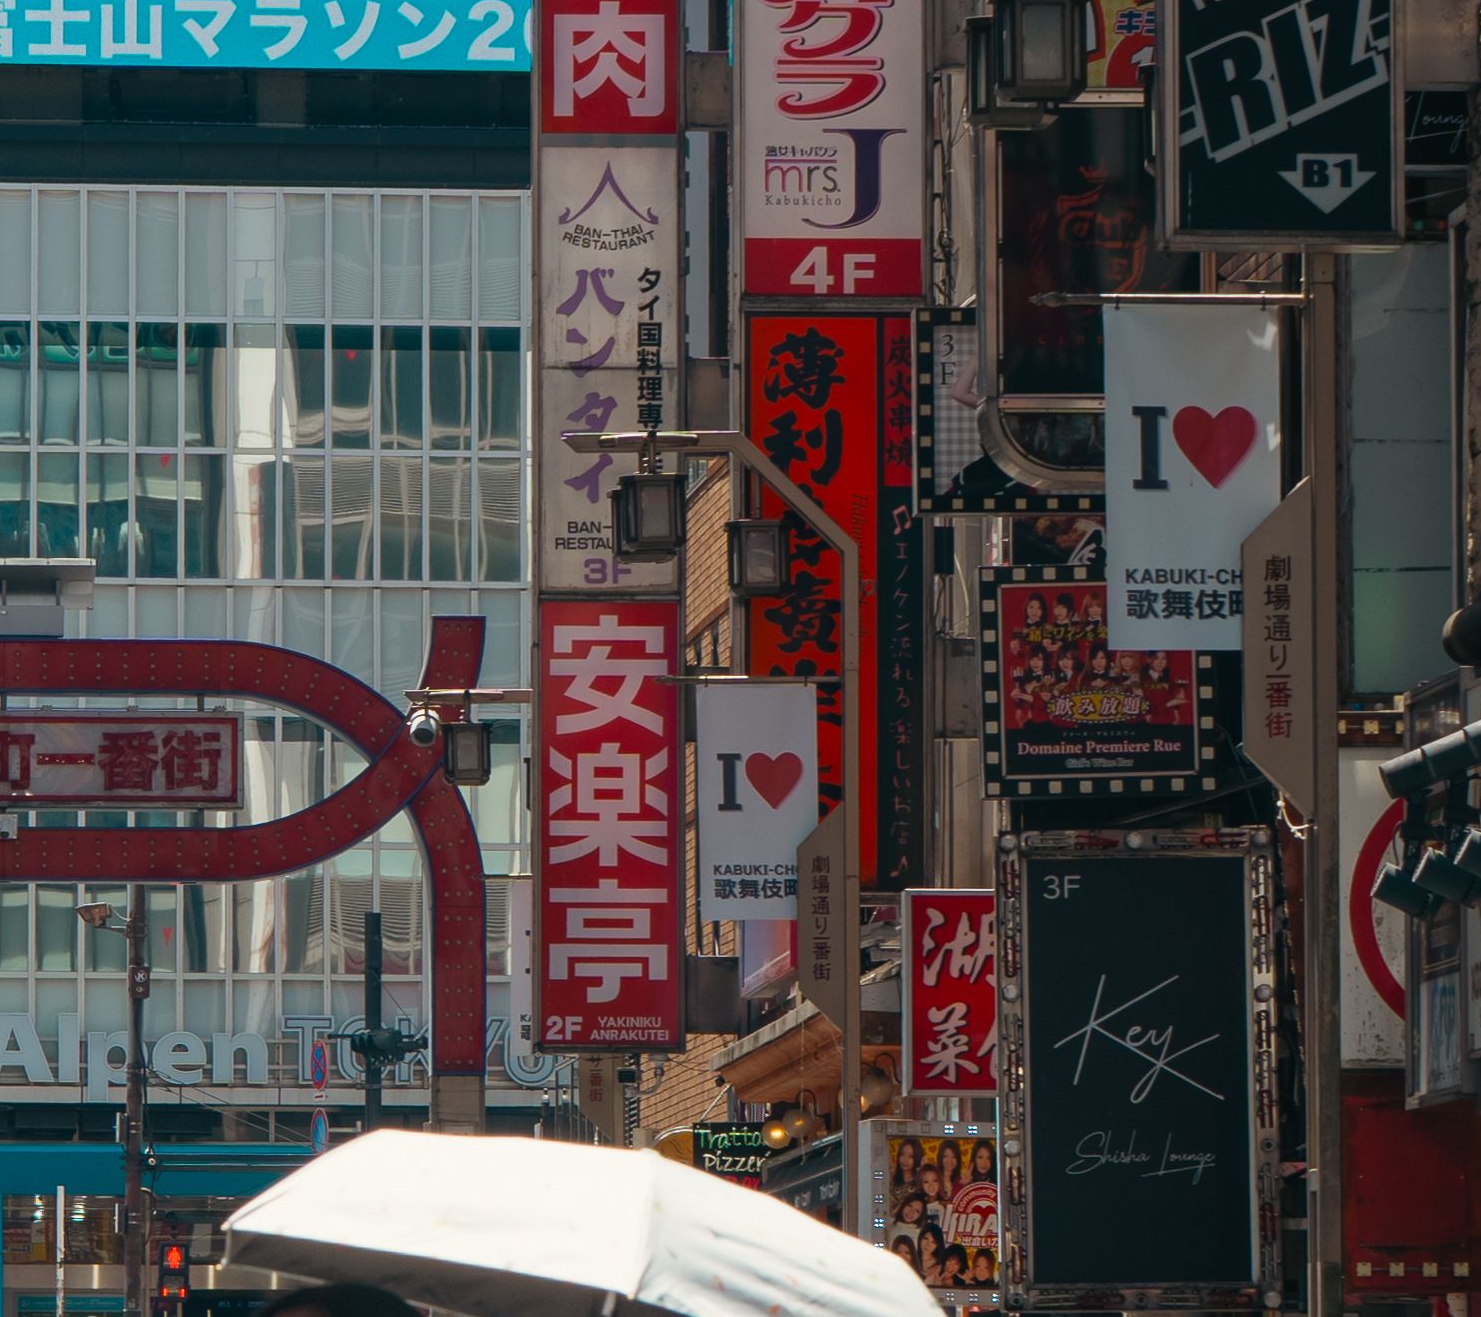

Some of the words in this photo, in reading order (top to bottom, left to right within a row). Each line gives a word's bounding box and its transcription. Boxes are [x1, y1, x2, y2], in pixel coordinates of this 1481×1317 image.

[1302, 159, 1357, 188] B1
[765, 194, 842, 207] Kabukicho
[790, 245, 876, 294] 4F
[556, 266, 625, 504] バンタイ
[1132, 406, 1169, 490] I
[1264, 555, 1293, 739] 劇場通り一番街
[1056, 696, 1141, 715] 飲み放題
[1018, 741, 1083, 755] Domaine
[1086, 740, 1150, 755] Premiere
[1154, 739, 1182, 752] Rue
[717, 753, 742, 812] I
[549, 615, 670, 1003] 安楽亭
[1043, 875, 1081, 899] 3F
[811, 855, 831, 981] 劇場通り一番街
[546, 1017, 582, 1041] 2F
[590, 1029, 670, 1042] ANRAKUTEI
[597, 1017, 662, 1029] YAKINIKU
[1054, 975, 1225, 1103] Key
